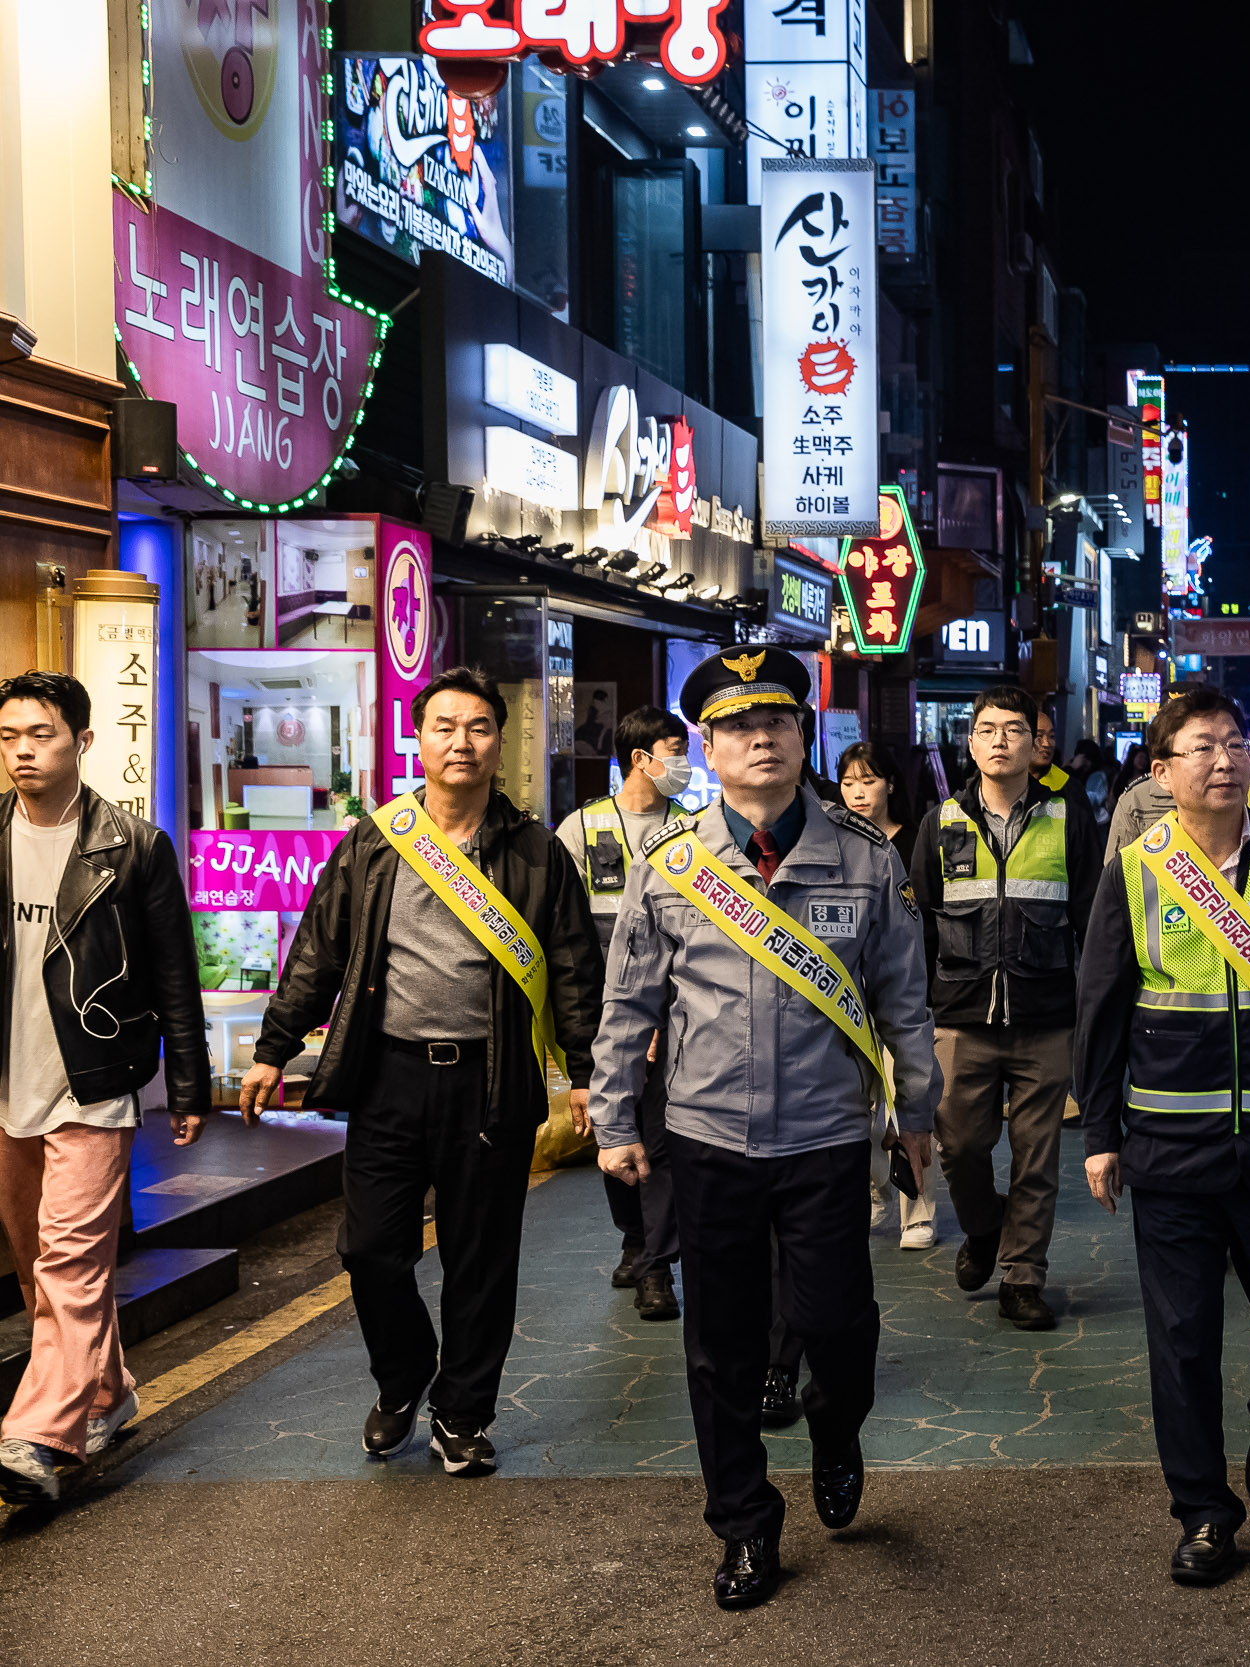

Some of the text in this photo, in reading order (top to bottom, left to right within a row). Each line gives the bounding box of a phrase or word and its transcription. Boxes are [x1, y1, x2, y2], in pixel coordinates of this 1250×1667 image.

[424, 154, 468, 209] IZAKAYA
[122, 222, 348, 431] 노래연습장
[848, 267, 863, 337] 이자카야
[209, 391, 293, 470] JJANG
[801, 405, 844, 425] 소주
[793, 434, 854, 457] 生맥주
[795, 495, 851, 515] 하이볼
[802, 465, 844, 487] 사케
[847, 544, 913, 580] 야장
[865, 580, 898, 643] 포차
[116, 652, 148, 742] 소주
[191, 889, 255, 907] 래연습장
[412, 833, 536, 968] 안전하고 건전한 청년의 거리
[1163, 849, 1230, 920] 안전하고
[690, 865, 770, 939] 범죄없는
[835, 985, 864, 1030] 거리
[813, 924, 852, 934] POLICE
